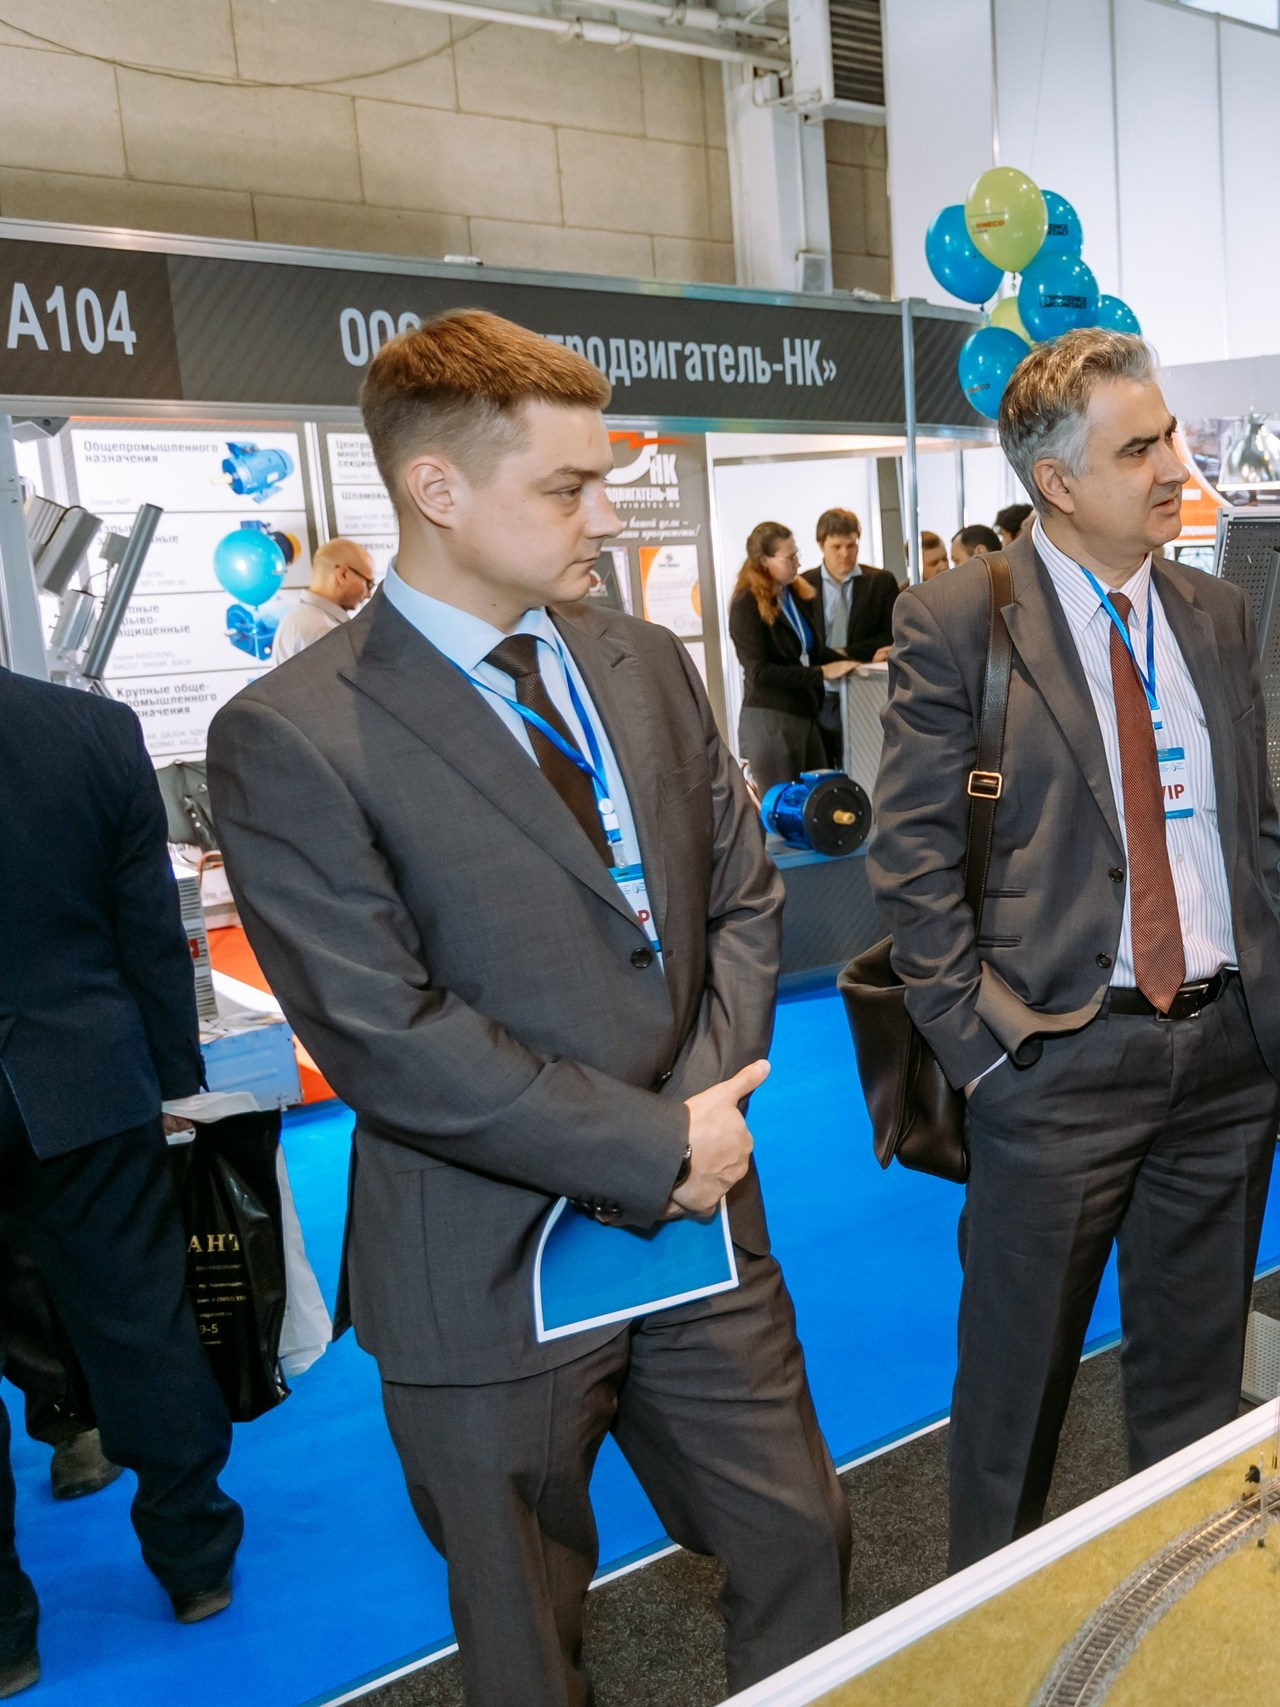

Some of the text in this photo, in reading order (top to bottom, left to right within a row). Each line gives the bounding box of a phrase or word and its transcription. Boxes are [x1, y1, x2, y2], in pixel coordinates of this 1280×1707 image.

[538, 334, 837, 387] родвигатель-НК»
[83, 440, 219, 454] Общепромышленного
[335, 440, 374, 450] Центро
[85, 453, 159, 464] назначения
[341, 491, 390, 500] Шламовы
[127, 604, 160, 614] пные
[121, 616, 158, 627] рыво-
[117, 625, 191, 638] щищенные
[116, 683, 211, 699] Крупные обще-
[125, 693, 218, 708] омышленного
[138, 706, 191, 718] начения
